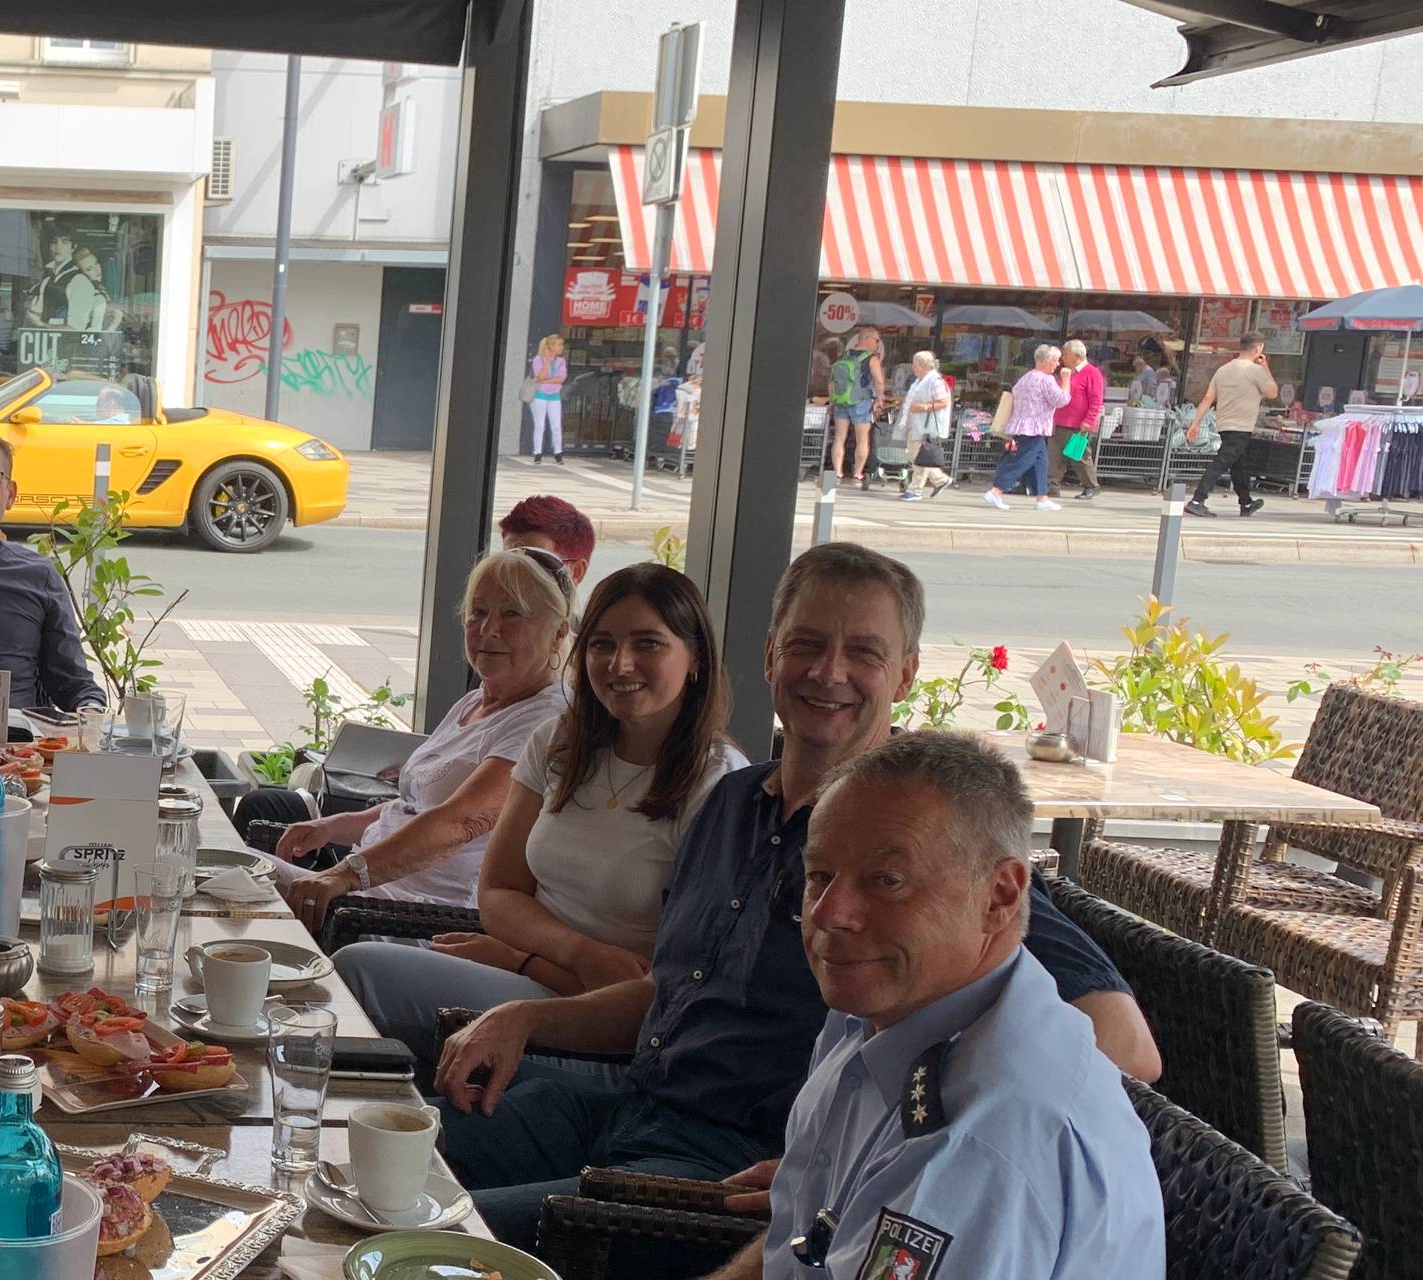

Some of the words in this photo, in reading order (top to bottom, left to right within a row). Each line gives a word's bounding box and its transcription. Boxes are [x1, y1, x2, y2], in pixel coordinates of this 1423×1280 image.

[823, 304, 856, 321] -50%
[19, 332, 62, 365] CUT
[80, 334, 103, 346] 24,-
[880, 1220, 940, 1256] POLIZEI
